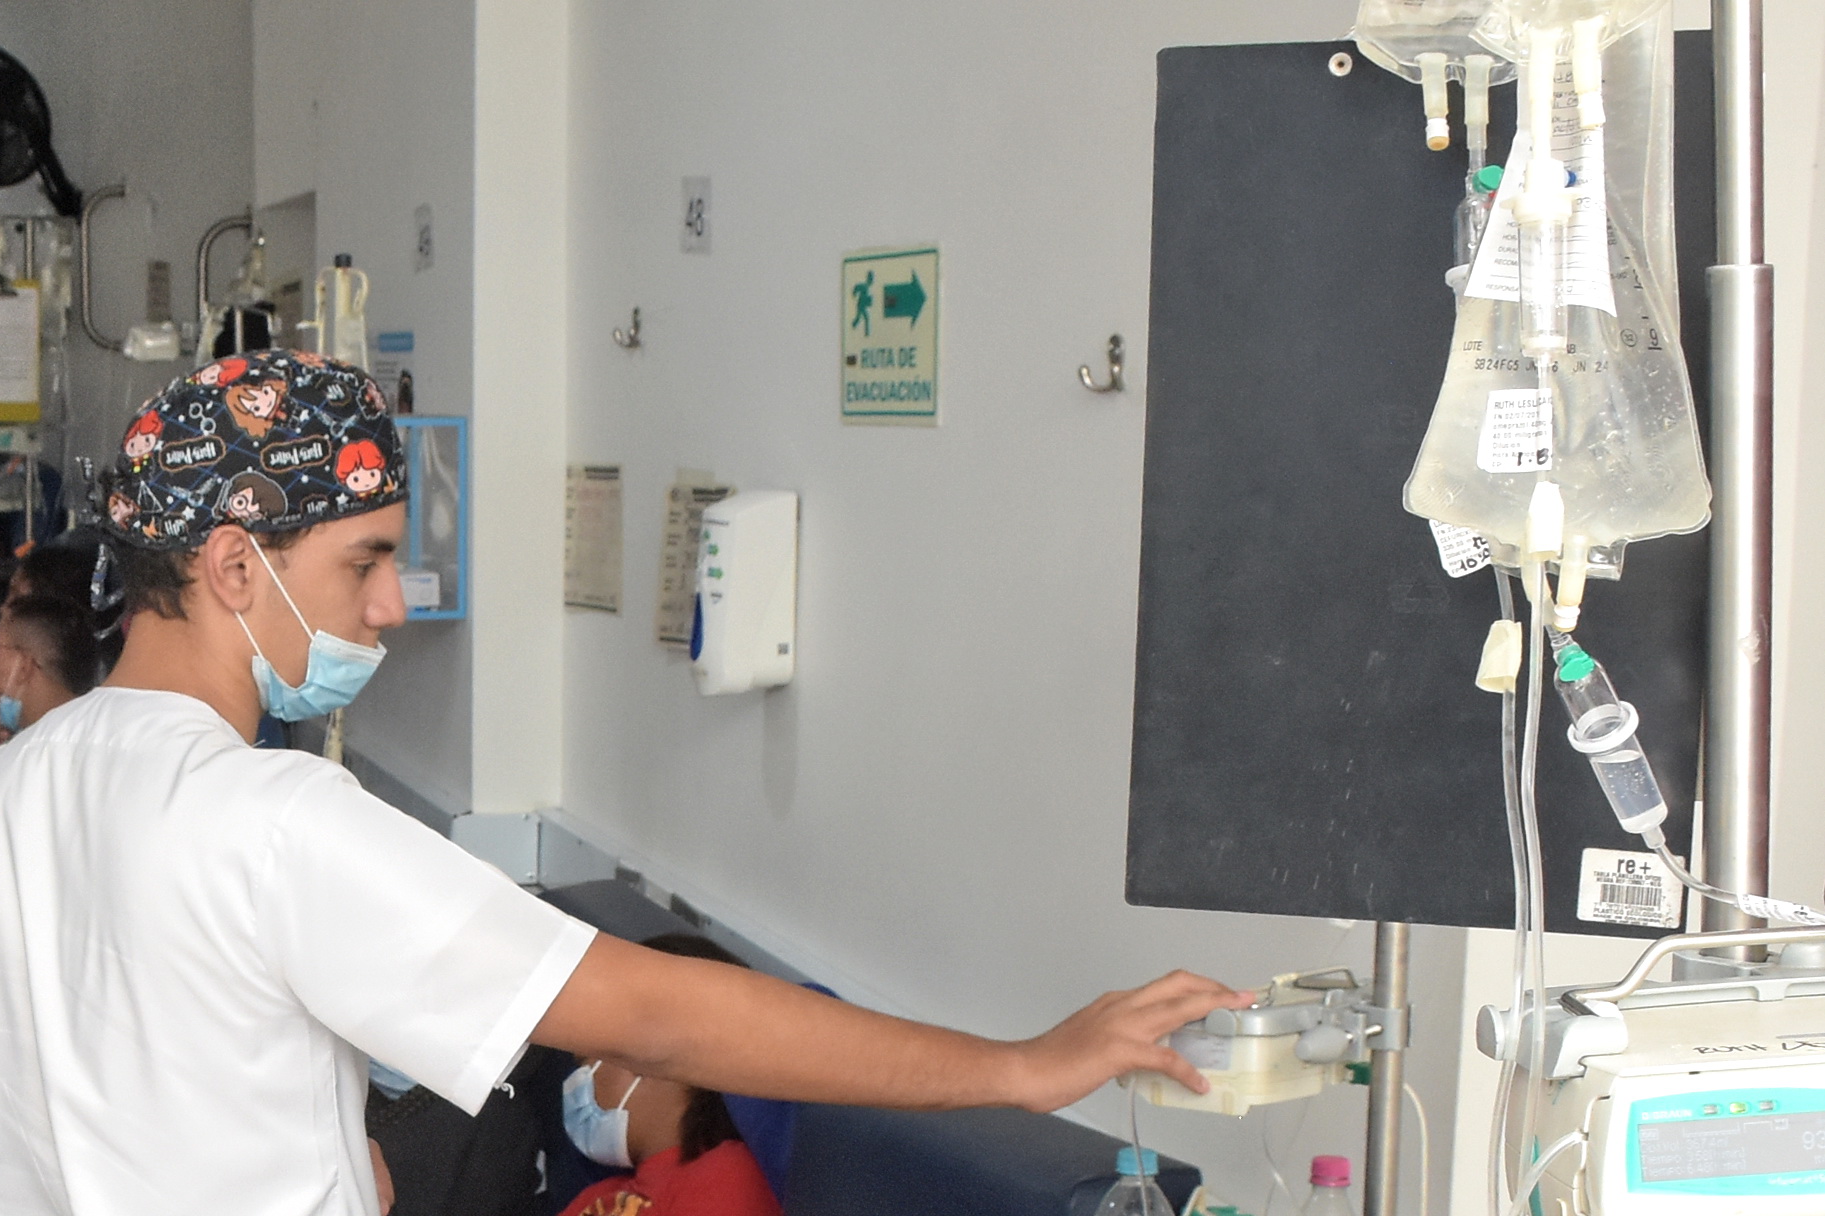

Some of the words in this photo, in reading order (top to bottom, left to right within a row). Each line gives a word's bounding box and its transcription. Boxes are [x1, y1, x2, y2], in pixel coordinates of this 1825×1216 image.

[1463, 340, 1483, 351] LOTE
[861, 347, 895, 368] RUTA
[899, 346, 916, 368] DE
[846, 375, 931, 402] EVACUACIÓN
[1494, 400, 1514, 409] RUTH
[166, 446, 193, 465] Potter
[193, 441, 217, 461] Harry
[270, 447, 300, 466] Potter
[299, 442, 323, 462] Harry
